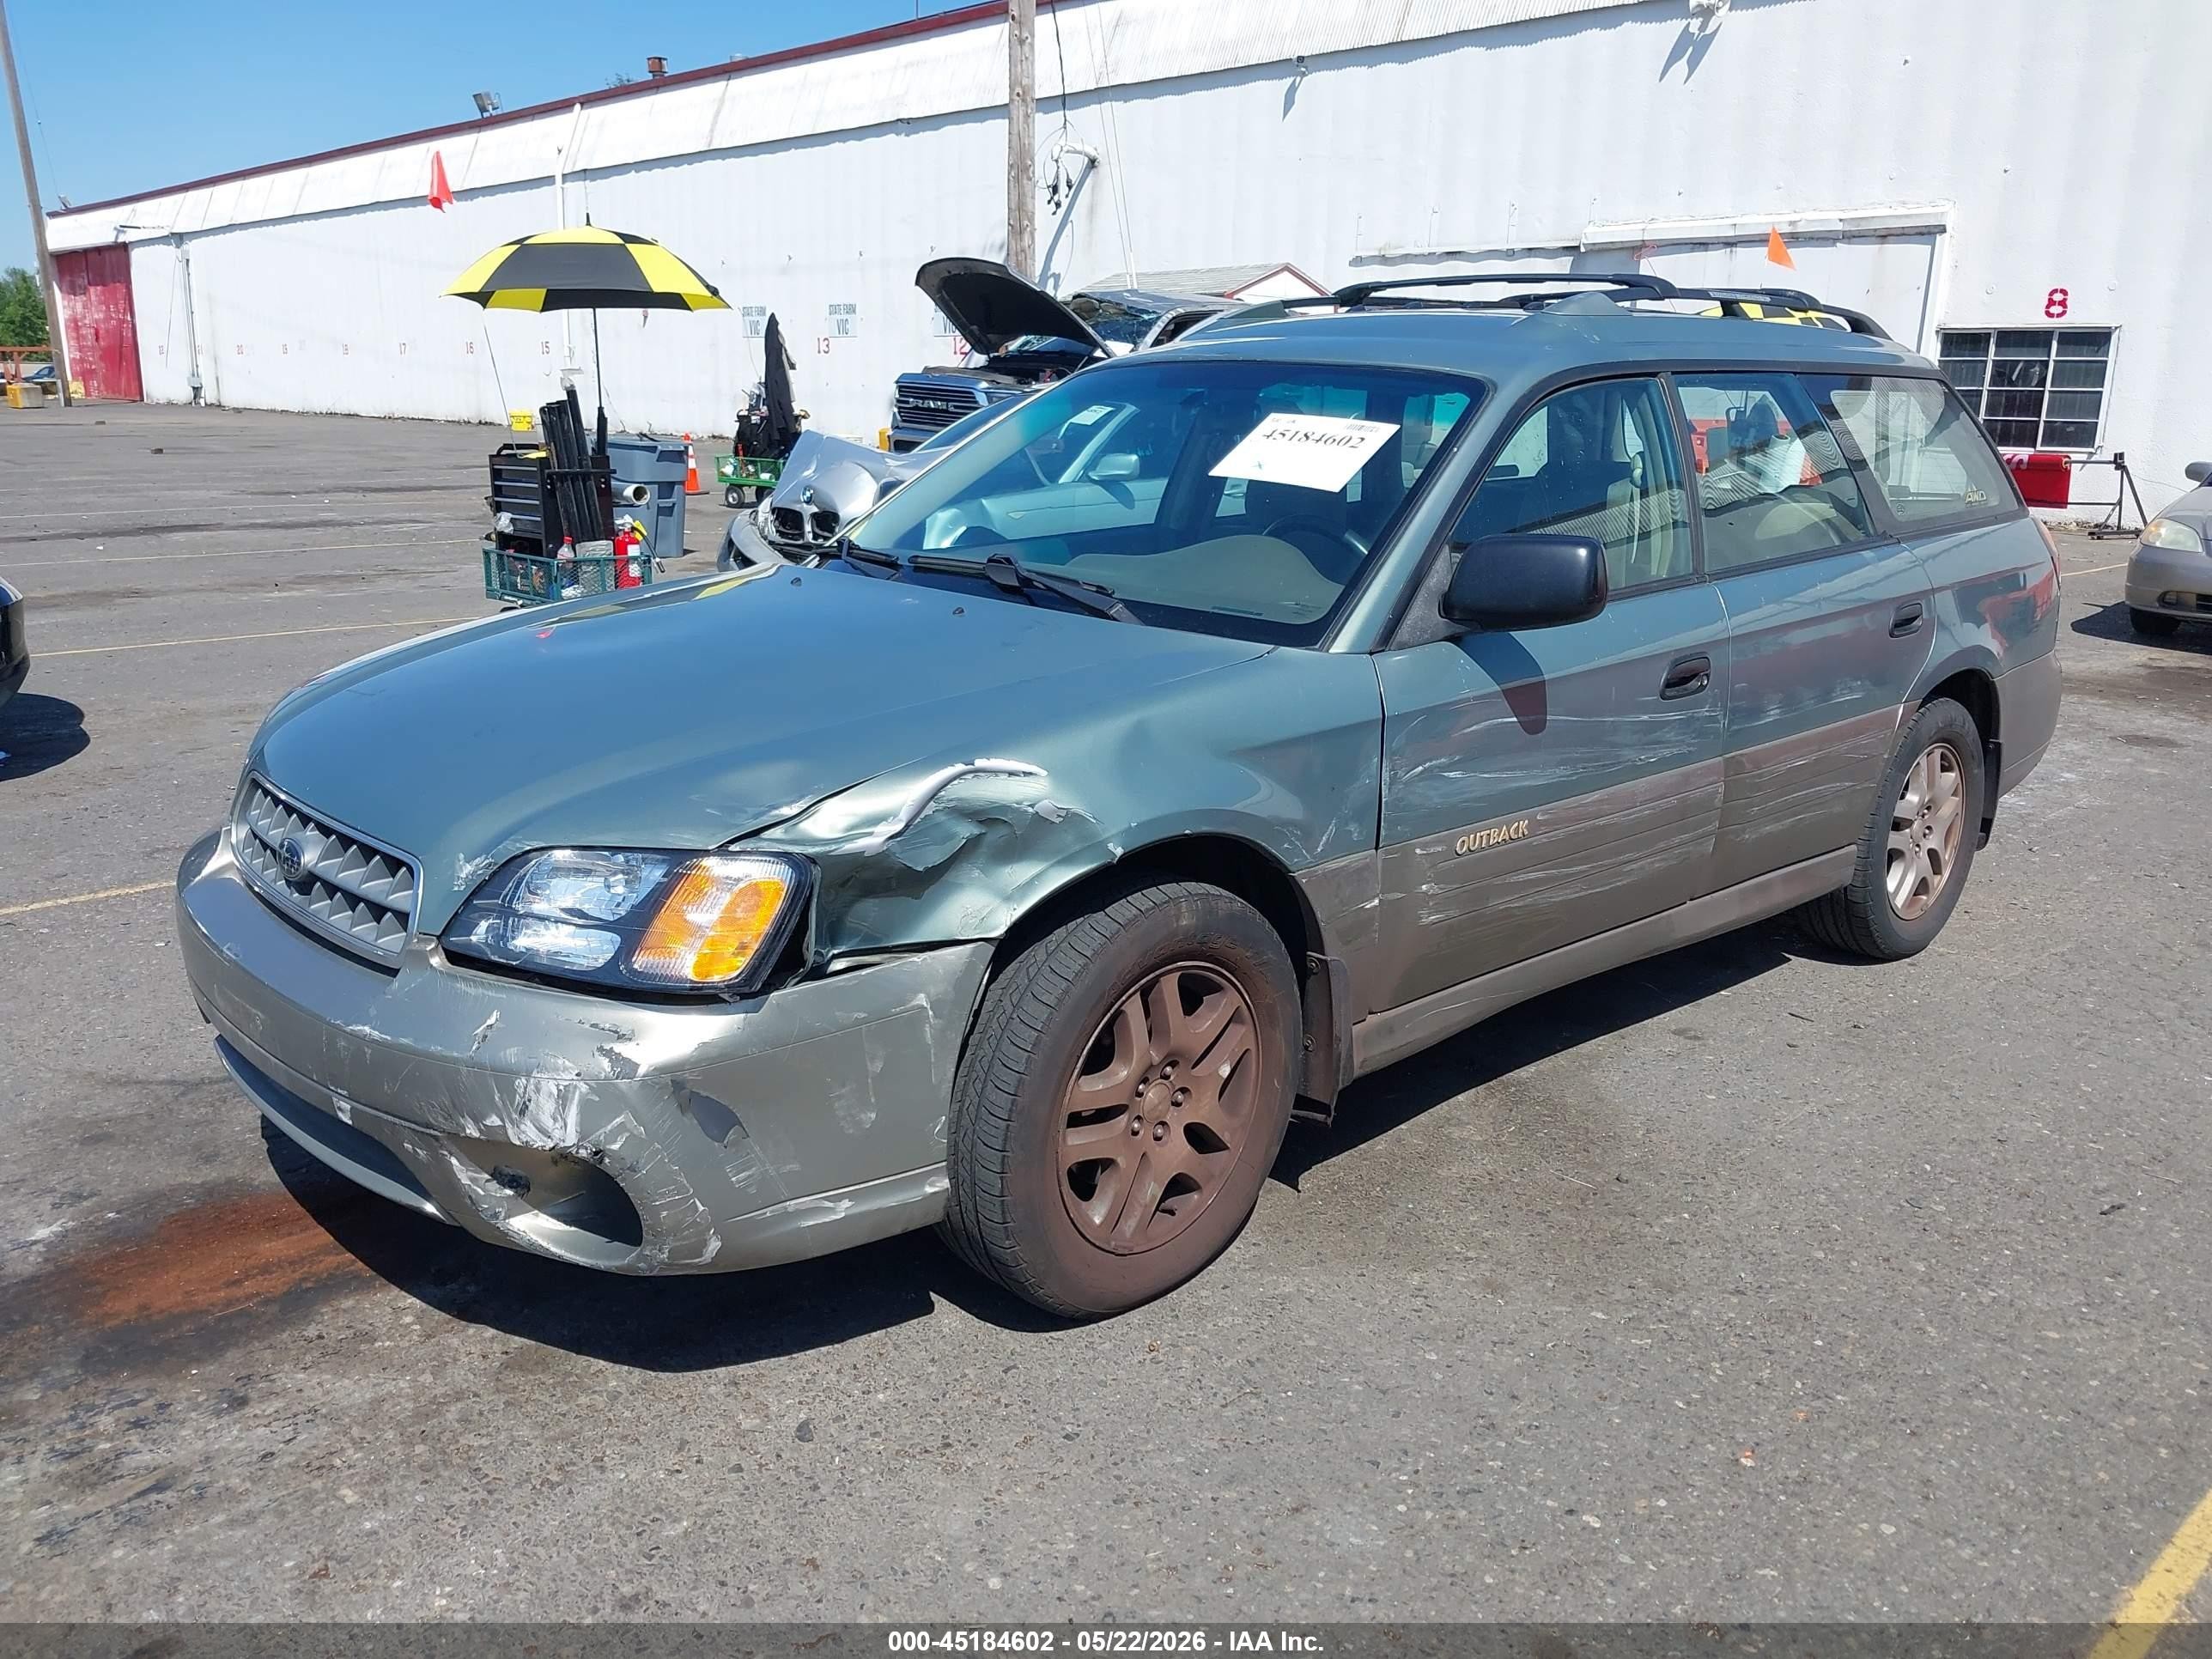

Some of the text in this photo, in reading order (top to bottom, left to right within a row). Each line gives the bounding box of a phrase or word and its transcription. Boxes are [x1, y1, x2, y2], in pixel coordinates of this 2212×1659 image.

[830, 303, 856, 315] STATE FARM
[2045, 288, 2068, 319] 8
[743, 307, 767, 317] STATE FARM
[749, 320, 760, 336] VIC
[836, 319, 849, 335] VIC
[399, 343, 406, 356] 17
[465, 342, 474, 355] 16
[541, 342, 550, 355] 15
[817, 337, 830, 354] 13
[952, 337, 968, 356] 12
[1262, 428, 1366, 449] 45184602
[1455, 820, 1528, 856] OUTBACK
